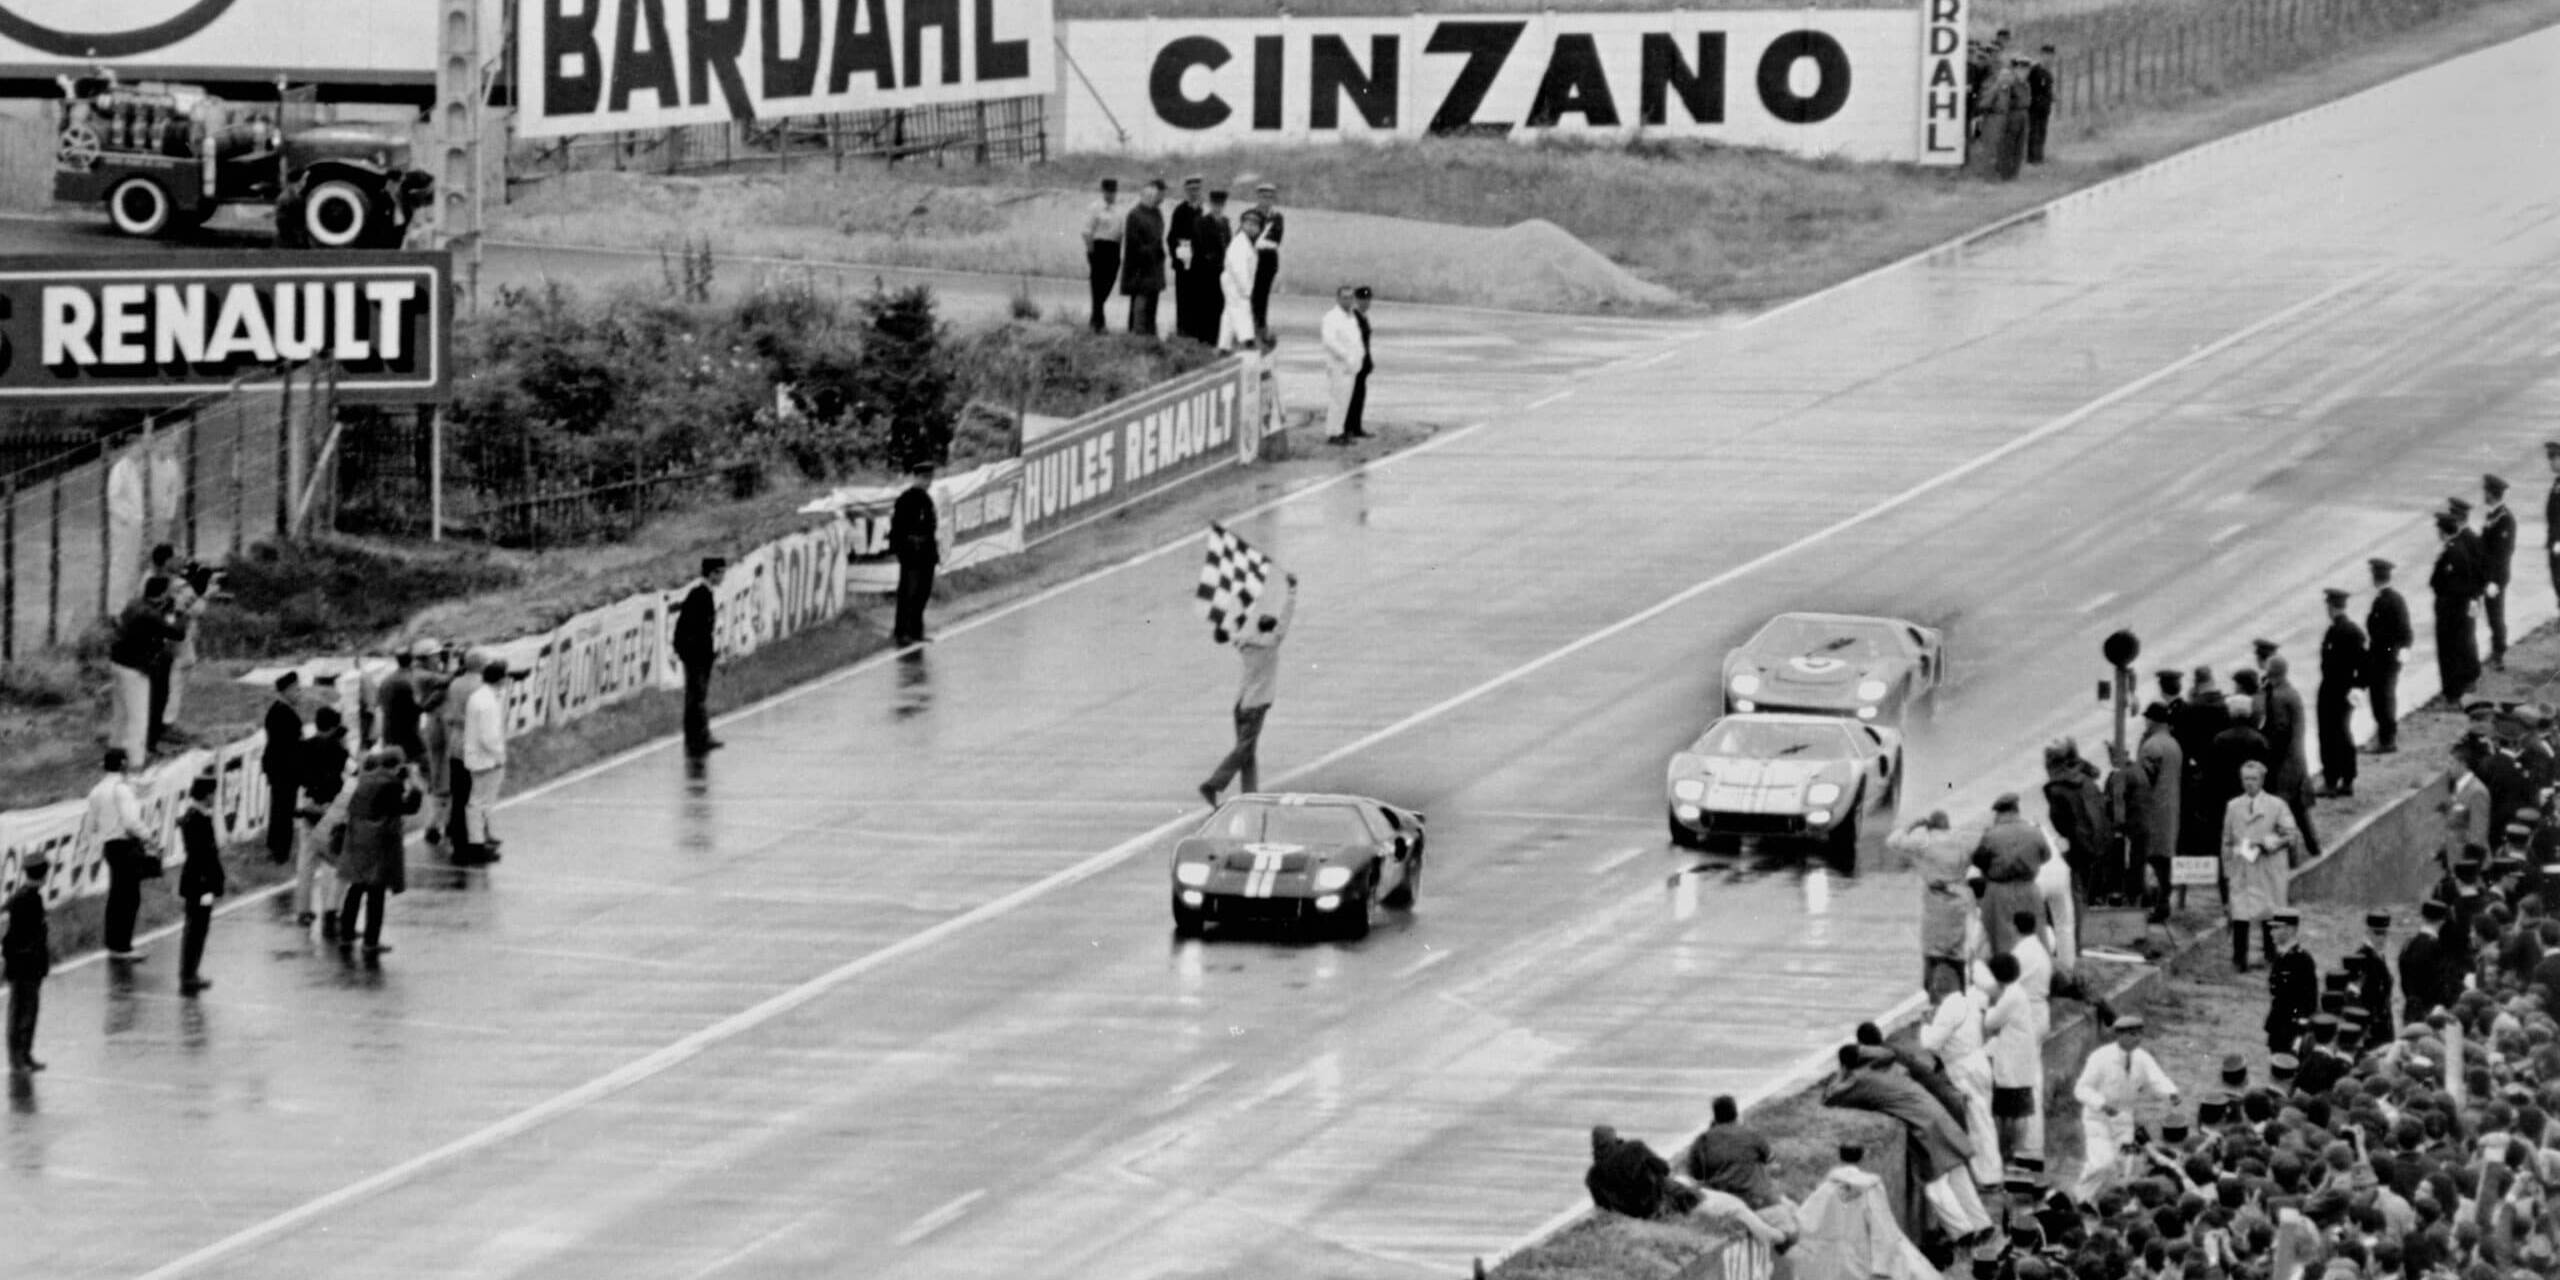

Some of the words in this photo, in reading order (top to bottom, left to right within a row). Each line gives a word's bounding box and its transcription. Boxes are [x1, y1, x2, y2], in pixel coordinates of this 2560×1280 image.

[543, 0, 1031, 120] BARDAHL
[1148, 20, 1852, 136] CINZANO
[41, 281, 416, 367] RENAULT
[1023, 430, 1116, 526] HUILES
[1124, 381, 1236, 483] RENAULT
[772, 520, 842, 638] SOLEX
